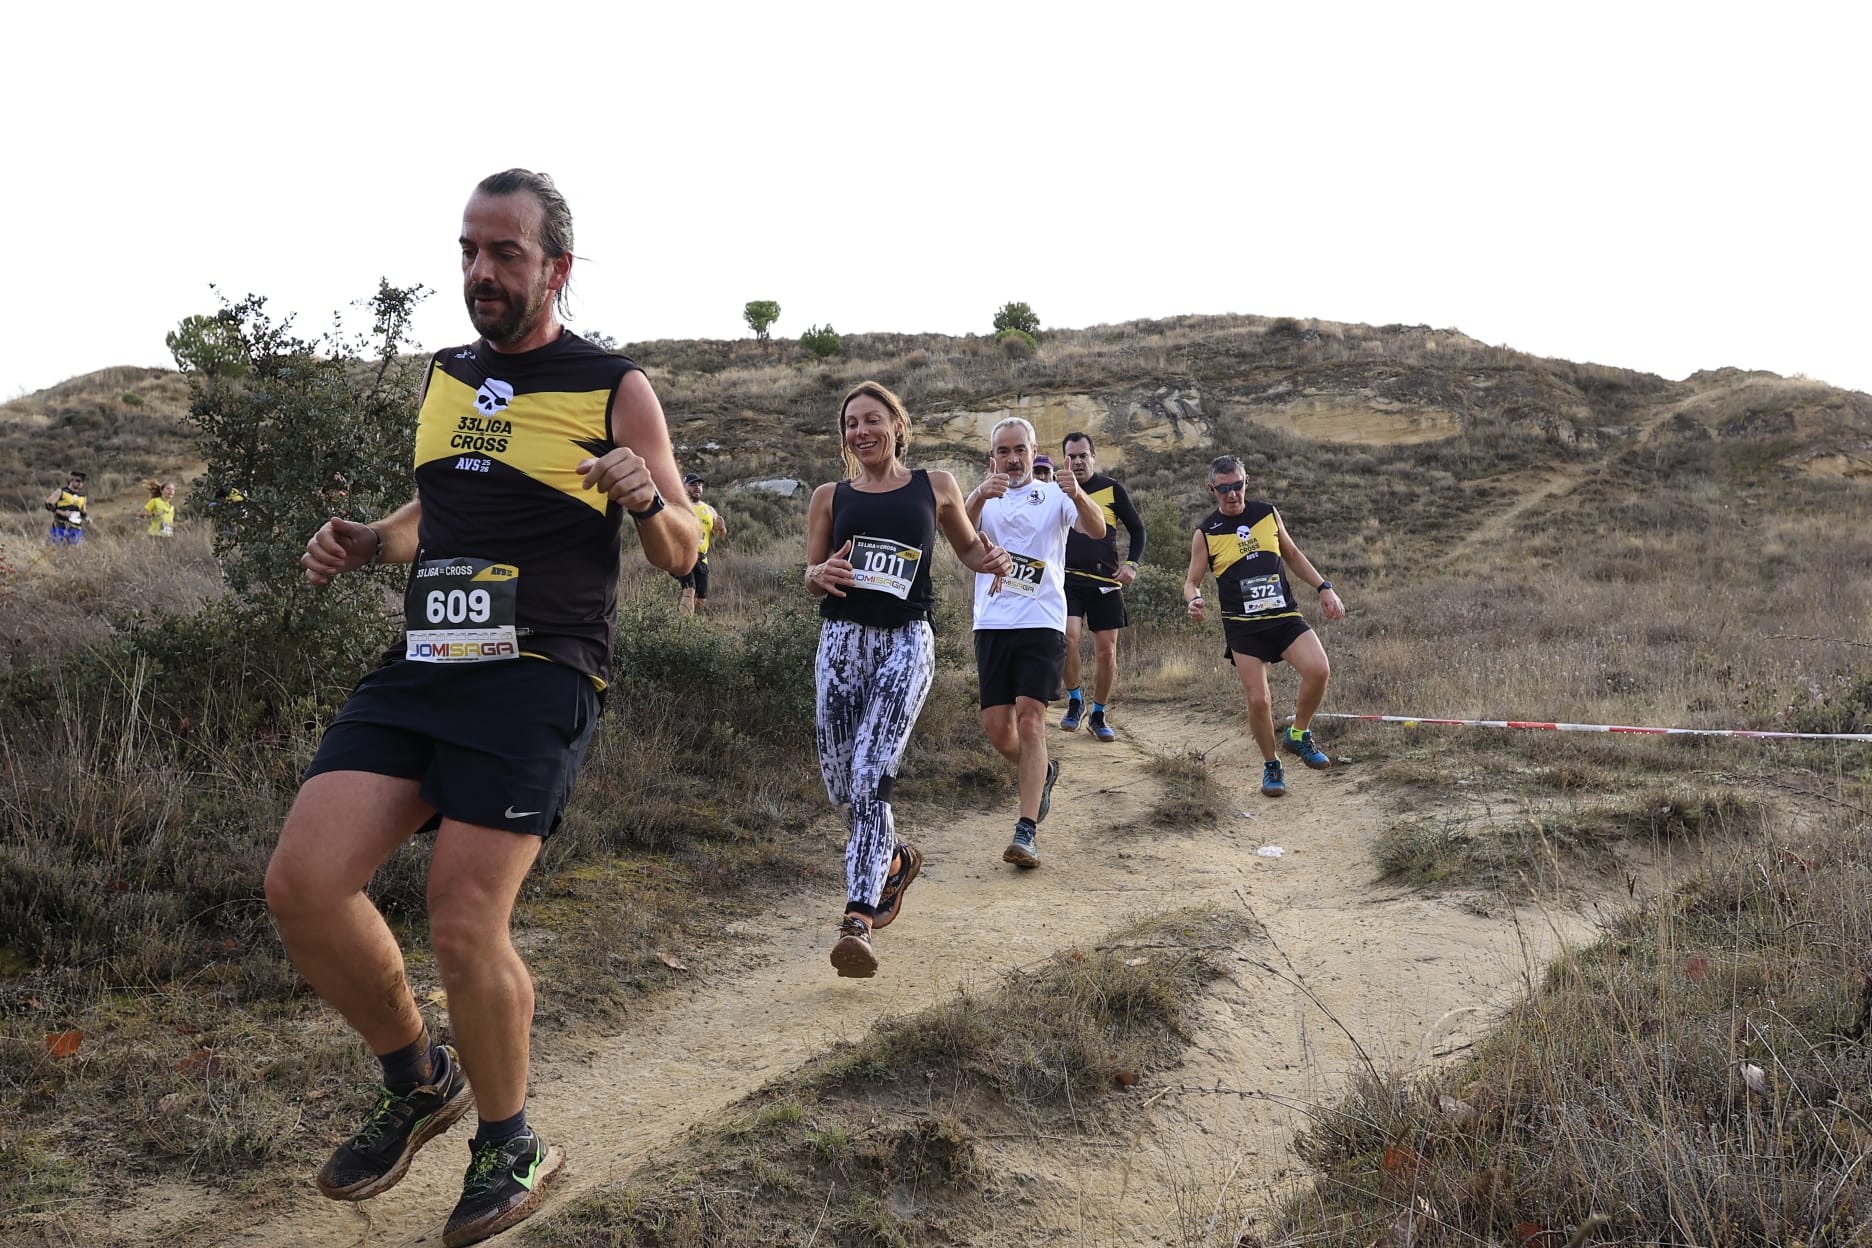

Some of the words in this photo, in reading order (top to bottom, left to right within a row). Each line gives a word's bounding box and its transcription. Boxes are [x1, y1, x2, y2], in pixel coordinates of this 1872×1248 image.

[450, 434, 509, 453] CROSS
[455, 457, 481, 471] AVS
[416, 568, 425, 579] 33
[424, 567, 439, 578] LIGA
[445, 565, 473, 576] CROSS
[864, 551, 905, 578] 1011
[1010, 561, 1036, 582] 012
[1249, 584, 1277, 599] 372
[426, 588, 491, 624] 609
[410, 641, 515, 658] JOMISAGA
